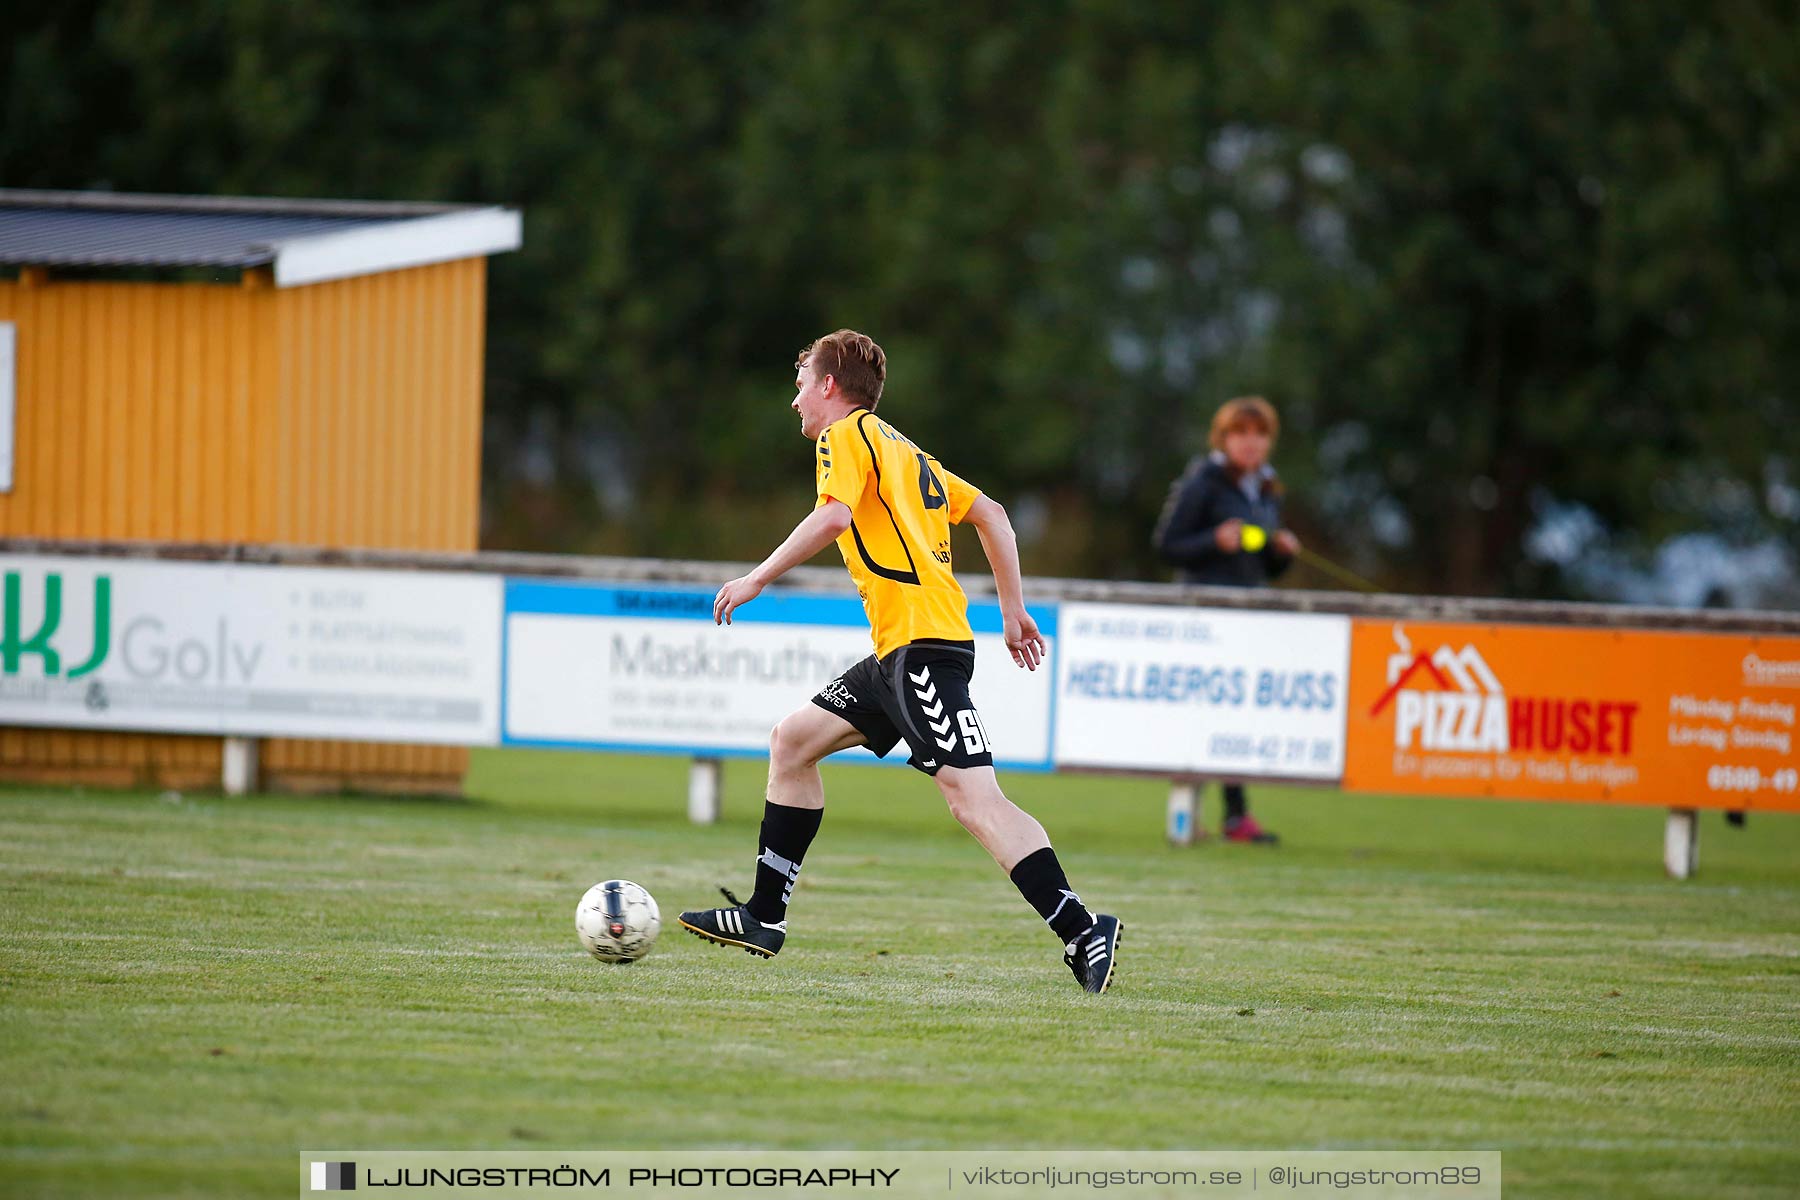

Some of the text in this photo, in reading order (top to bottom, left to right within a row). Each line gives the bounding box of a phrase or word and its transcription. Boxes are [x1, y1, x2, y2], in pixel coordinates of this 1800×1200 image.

[916, 453, 948, 510] 4
[121, 615, 265, 683] Golv
[86, 680, 110, 711] &
[1066, 659, 1338, 711] HELLBERGS BUSS
[1569, 760, 1640, 787] familjen
